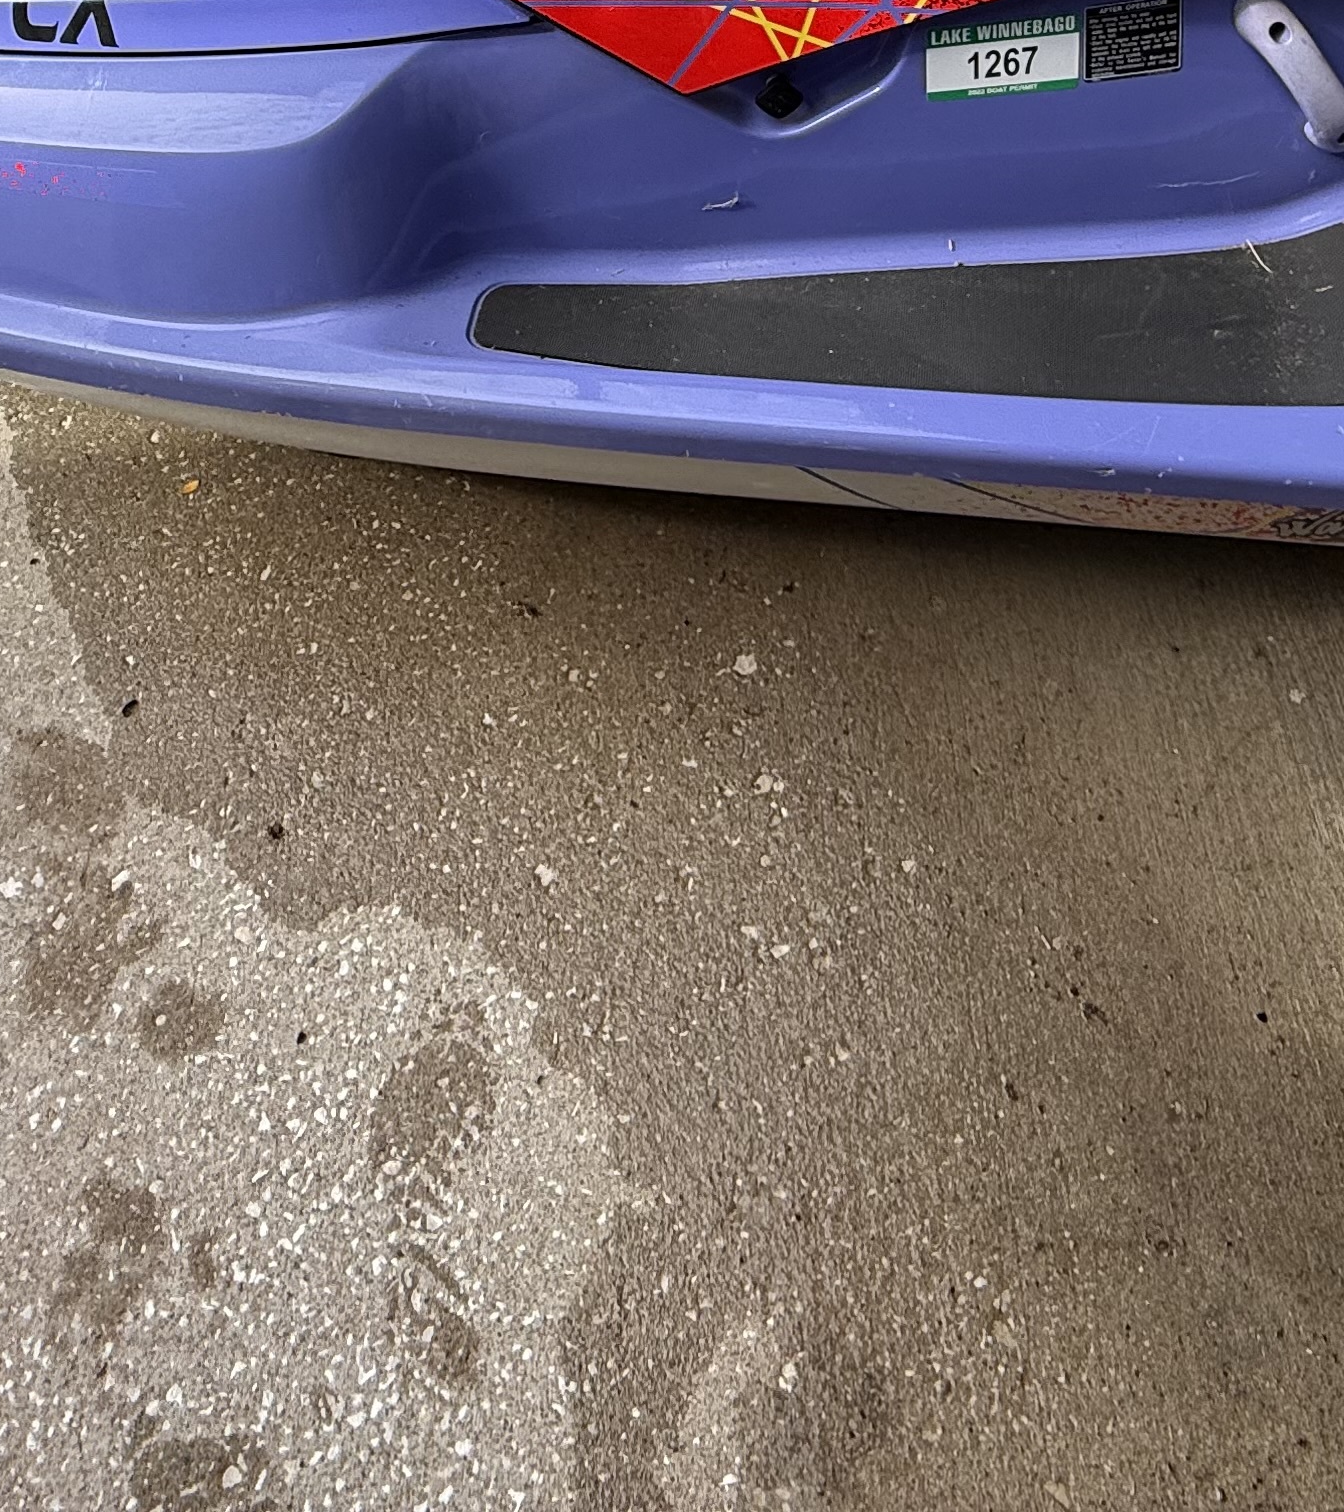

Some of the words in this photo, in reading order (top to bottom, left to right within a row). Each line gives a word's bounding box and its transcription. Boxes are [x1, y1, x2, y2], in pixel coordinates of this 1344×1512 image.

[930, 28, 971, 46] LAKE
[976, 15, 1076, 41] WINNEBAGO
[967, 46, 1038, 80] 1267
[986, 86, 1008, 94] BOAT
[1009, 83, 1038, 92] PERMIT
